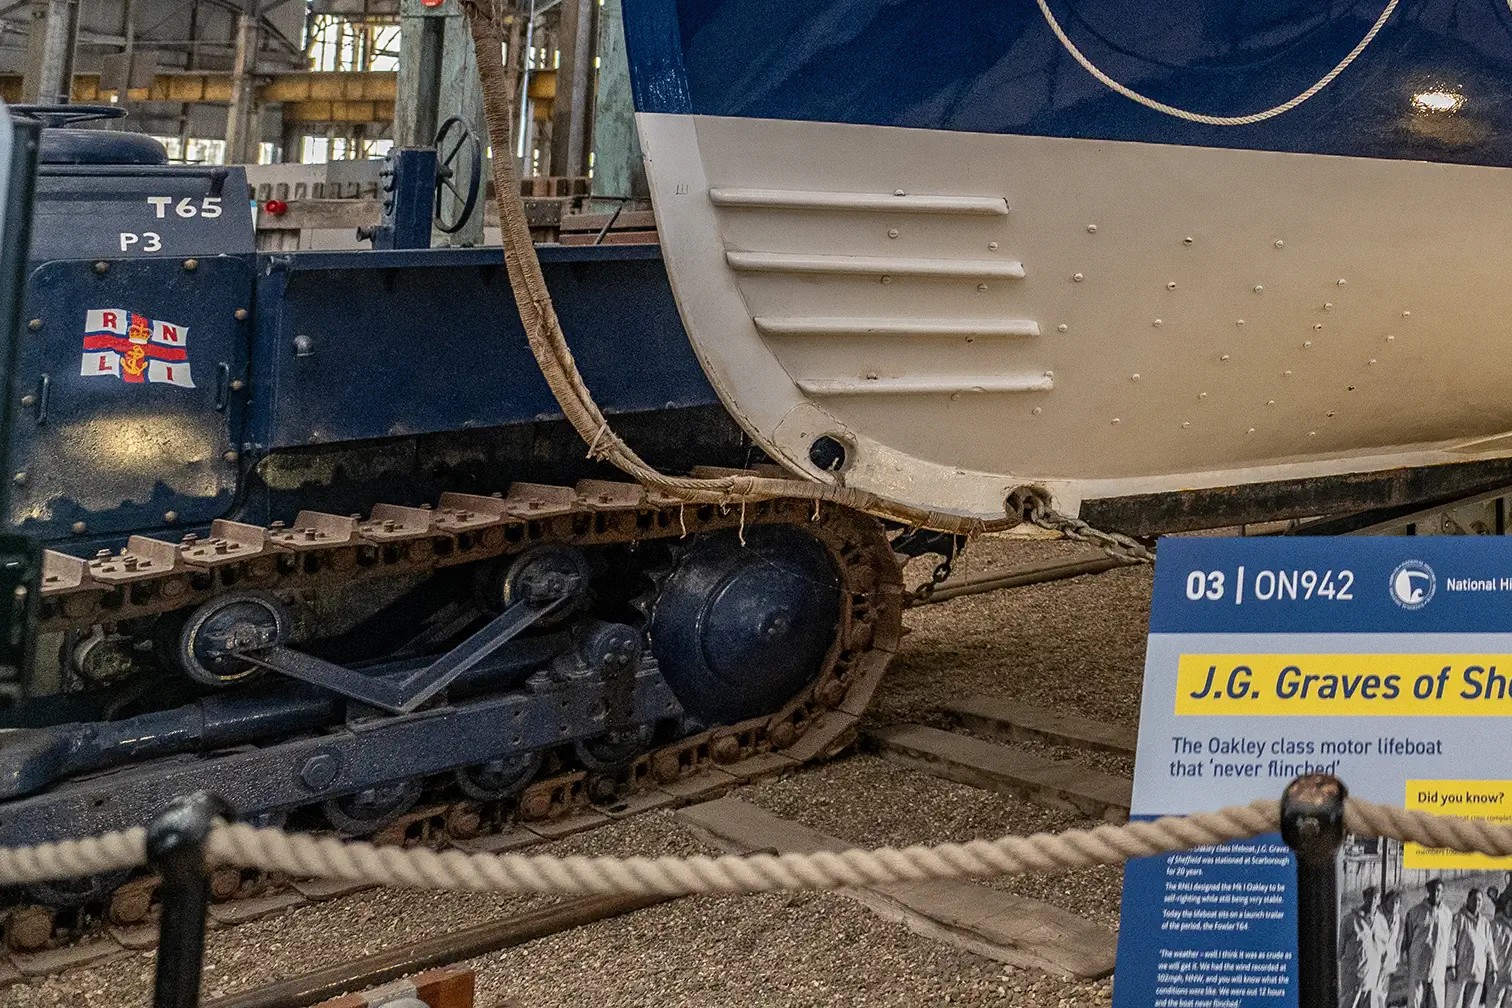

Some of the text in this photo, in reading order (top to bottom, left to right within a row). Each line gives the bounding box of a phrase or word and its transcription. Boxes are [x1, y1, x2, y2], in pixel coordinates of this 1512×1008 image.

[147, 196, 223, 219] T65
[120, 232, 162, 252] P3
[102, 311, 179, 343] R N
[99, 356, 174, 381] L I
[1186, 570, 1225, 601] 03
[1254, 569, 1355, 601] ON942
[1447, 577, 1496, 592] National
[1190, 665, 1260, 700] J.G.
[1275, 666, 1401, 700] Graves
[1413, 666, 1450, 700] of
[1172, 736, 1443, 758] The Oakley class motor lifeboat
[1169, 759, 1203, 776] that
[1418, 791, 1505, 806] Did you know?
[1252, 857, 1290, 866] Scarborough
